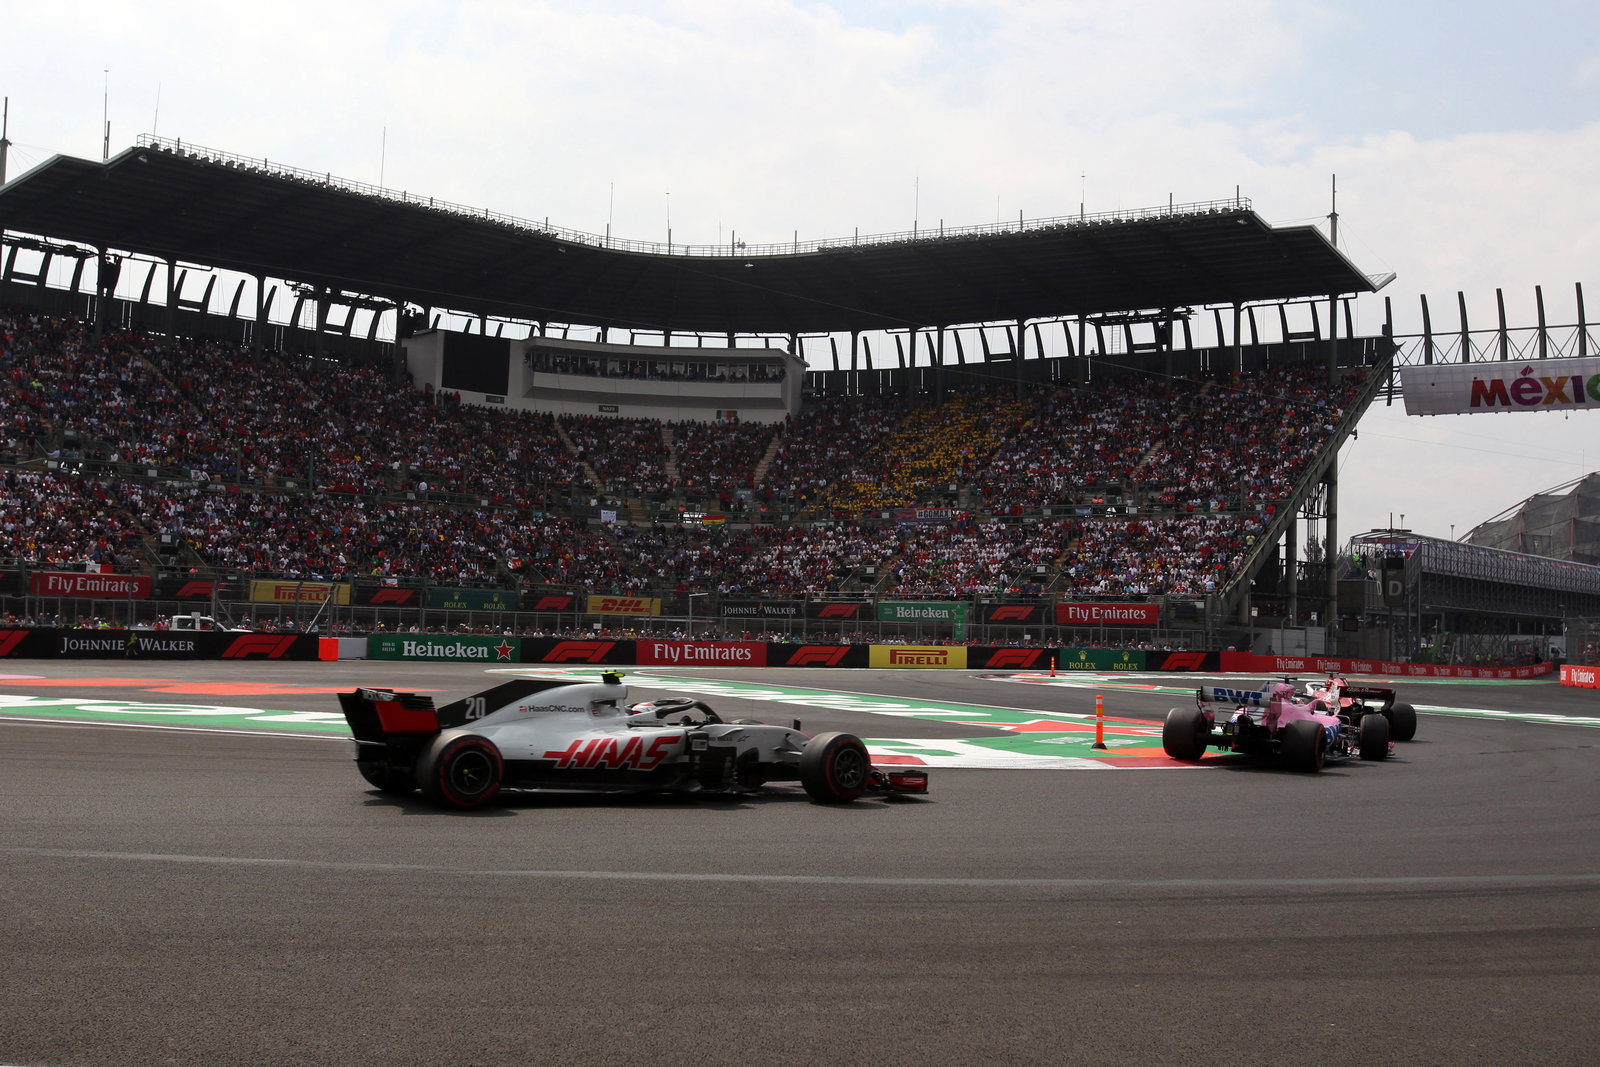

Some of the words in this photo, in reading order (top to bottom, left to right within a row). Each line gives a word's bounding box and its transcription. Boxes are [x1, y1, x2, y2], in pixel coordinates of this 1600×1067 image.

[48, 576, 73, 592] Fly
[76, 577, 139, 593] Emirates
[274, 585, 329, 600] PIRELLI
[444, 601, 467, 609] ROLEX
[599, 598, 648, 613] DHL
[723, 606, 757, 616] JOHNNIE
[763, 606, 796, 615] WALKER
[896, 606, 949, 619] Heineken
[1068, 607, 1089, 621] Fly
[1092, 607, 1146, 620] Emirates
[61, 637, 125, 653] JOHNNIE
[139, 638, 194, 651] WALKER
[402, 641, 488, 658] Heineken
[654, 643, 680, 663] Fly
[684, 644, 751, 660] Emirates
[889, 649, 948, 665] PIRELLI
[1277, 658, 1285, 670] Fly
[1286, 658, 1304, 669] Emirates
[1213, 687, 1263, 705] BWT
[465, 697, 486, 719] 20
[529, 704, 585, 713] HaasCNC.com
[542, 735, 681, 771] HAAS
